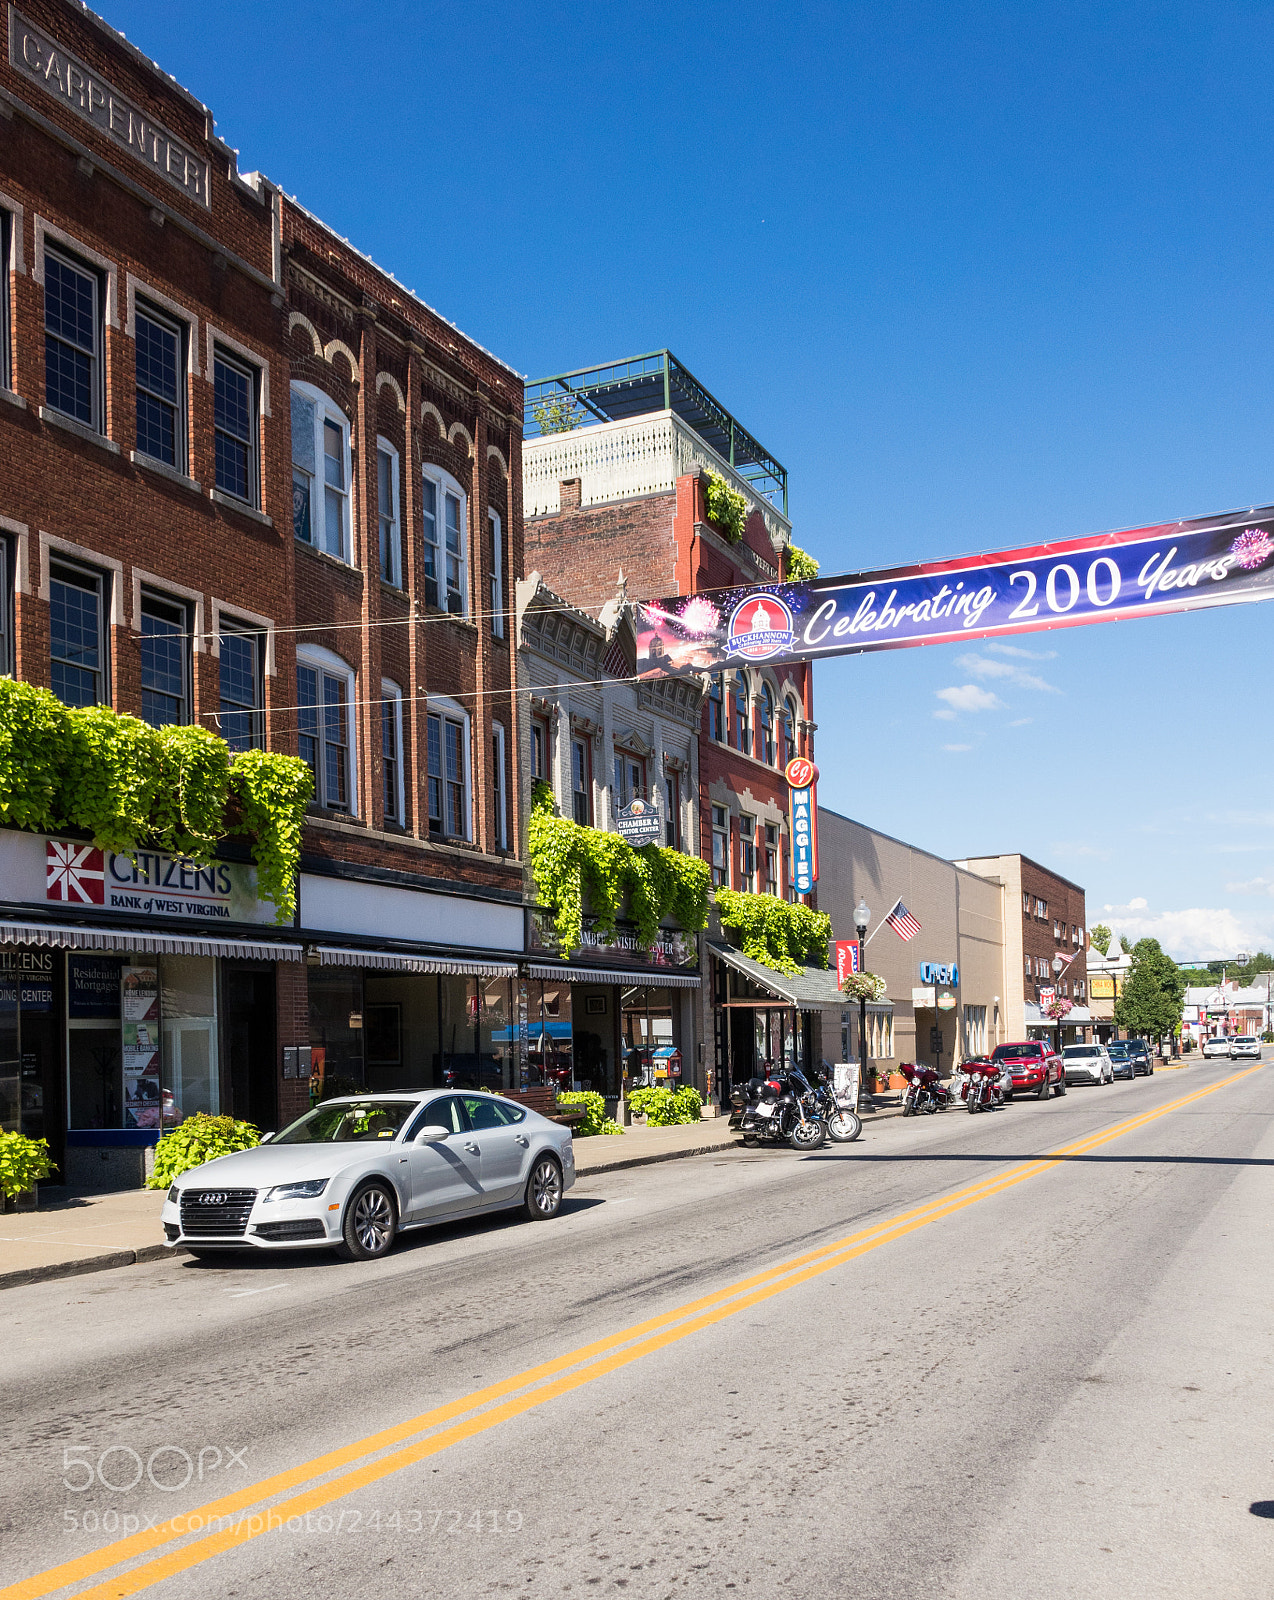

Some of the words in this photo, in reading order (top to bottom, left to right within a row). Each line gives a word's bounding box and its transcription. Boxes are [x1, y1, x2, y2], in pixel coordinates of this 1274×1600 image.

[23, 33, 200, 194] CARPENTER
[803, 582, 997, 645] Celebrating
[1008, 557, 1121, 619] 200
[1137, 547, 1235, 600] Years
[731, 632, 789, 646] BUCKHANNON
[618, 819, 652, 829] CHAMBER
[653, 818, 659, 826] &
[794, 791, 810, 890] MAGGIES
[109, 848, 232, 895] CITIZENS
[111, 895, 142, 909] BANK
[143, 898, 155, 913] of
[155, 900, 184, 913] WEST
[185, 902, 231, 917] VIRGINIA
[73, 967, 120, 980] Residential
[75, 980, 119, 993] Mortgages
[21, 990, 53, 1002] CENTER
